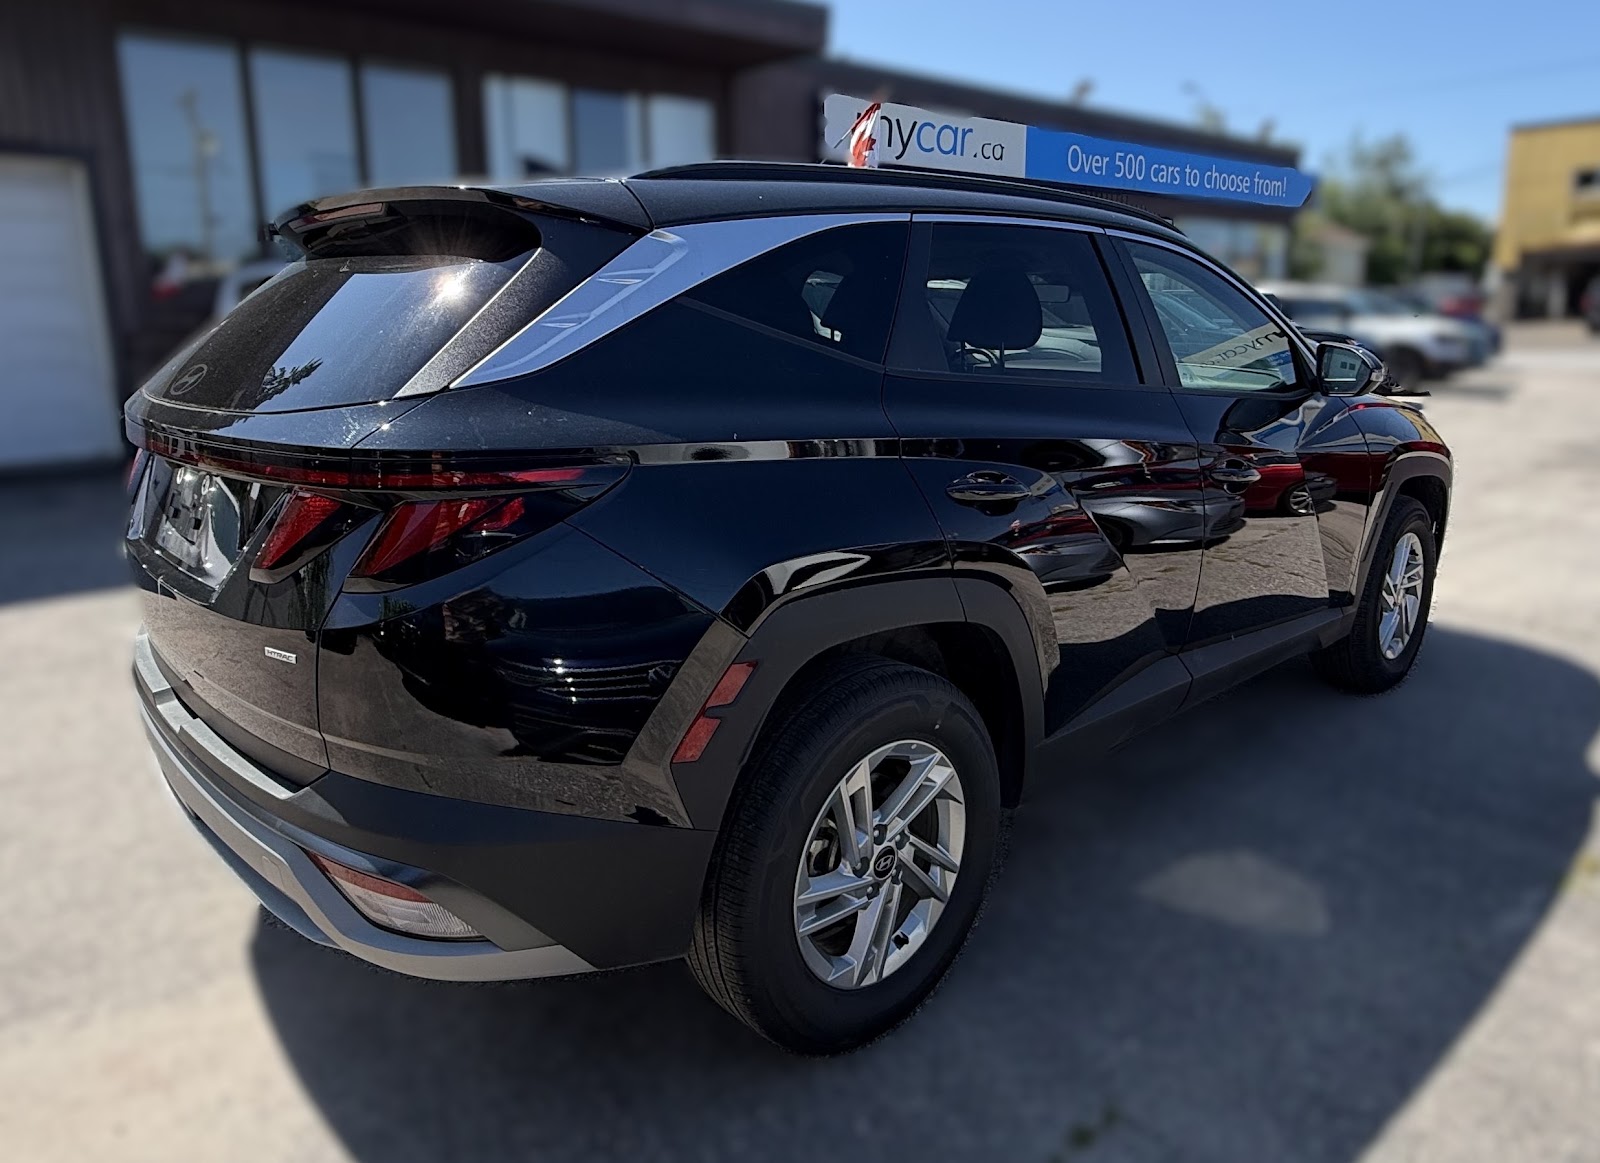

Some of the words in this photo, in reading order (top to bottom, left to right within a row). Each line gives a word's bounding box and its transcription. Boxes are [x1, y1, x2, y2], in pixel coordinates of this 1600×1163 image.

[1067, 144, 1110, 176] Over
[1115, 152, 1146, 181] 500
[1150, 163, 1181, 185] cars
[1185, 164, 1200, 188] to
[1204, 165, 1251, 194] choose
[1254, 172, 1288, 198] from!
[266, 649, 295, 662] HTRAC
